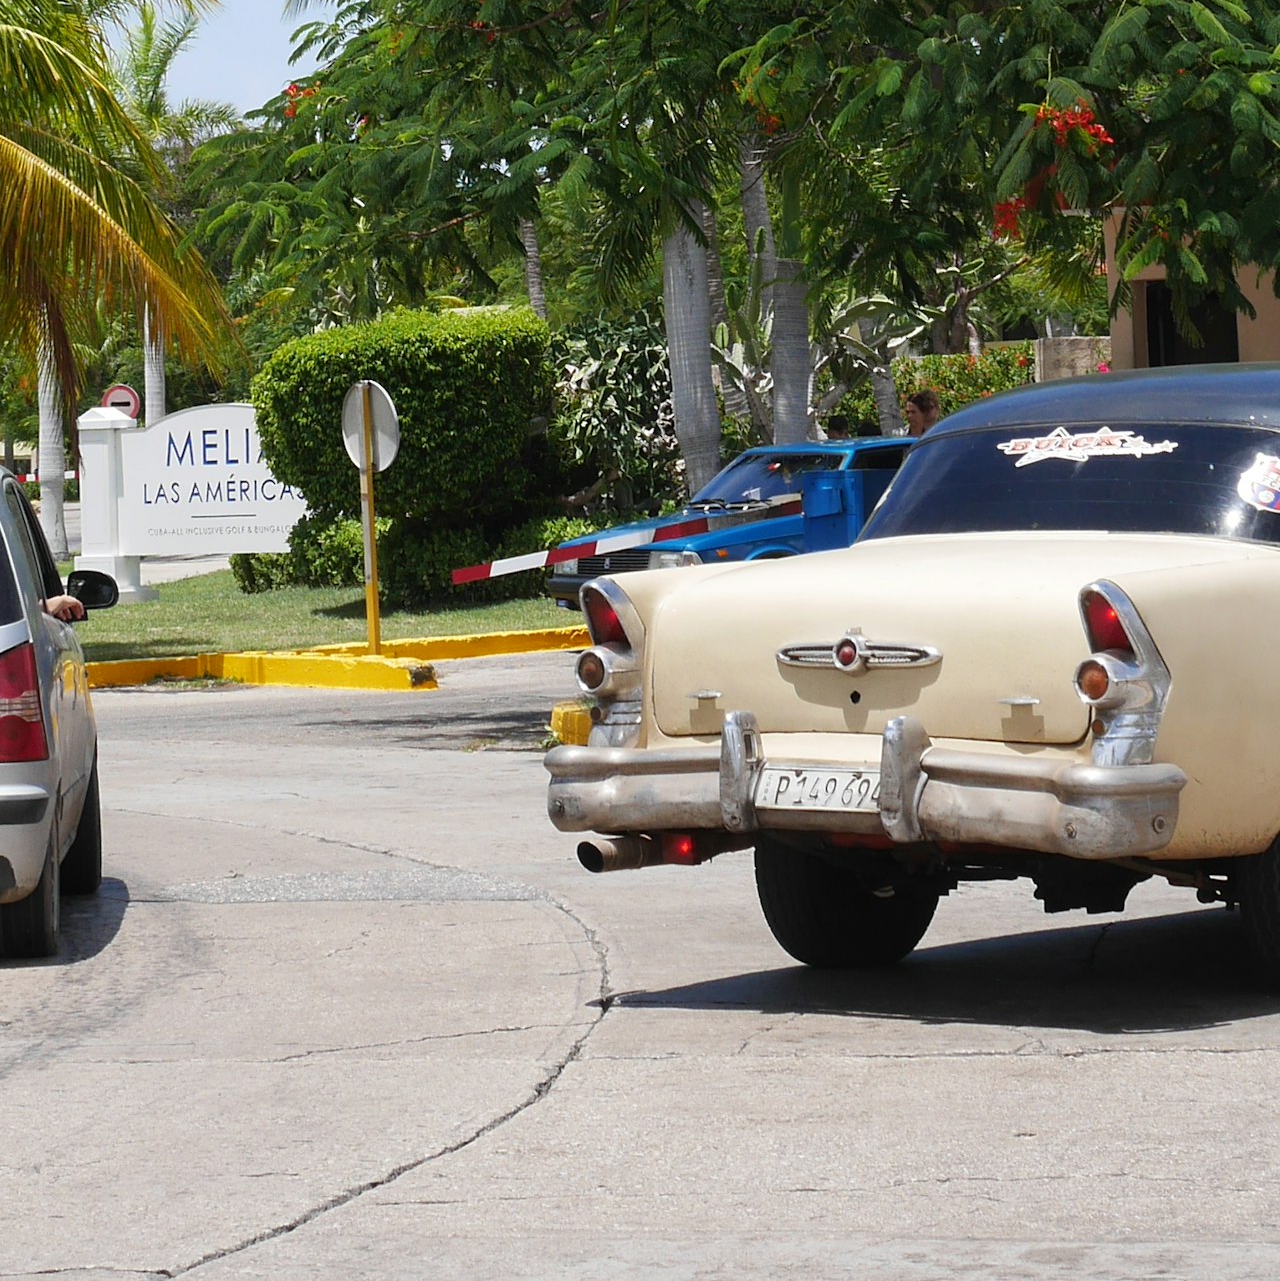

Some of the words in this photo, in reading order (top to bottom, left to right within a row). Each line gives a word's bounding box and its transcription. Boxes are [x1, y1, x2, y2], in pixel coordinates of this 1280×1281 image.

[143, 483, 181, 505] LAS
[185, 526, 223, 536] INCLUSIVE
[225, 525, 246, 535] GOLF
[254, 524, 292, 534] BUNGALO
